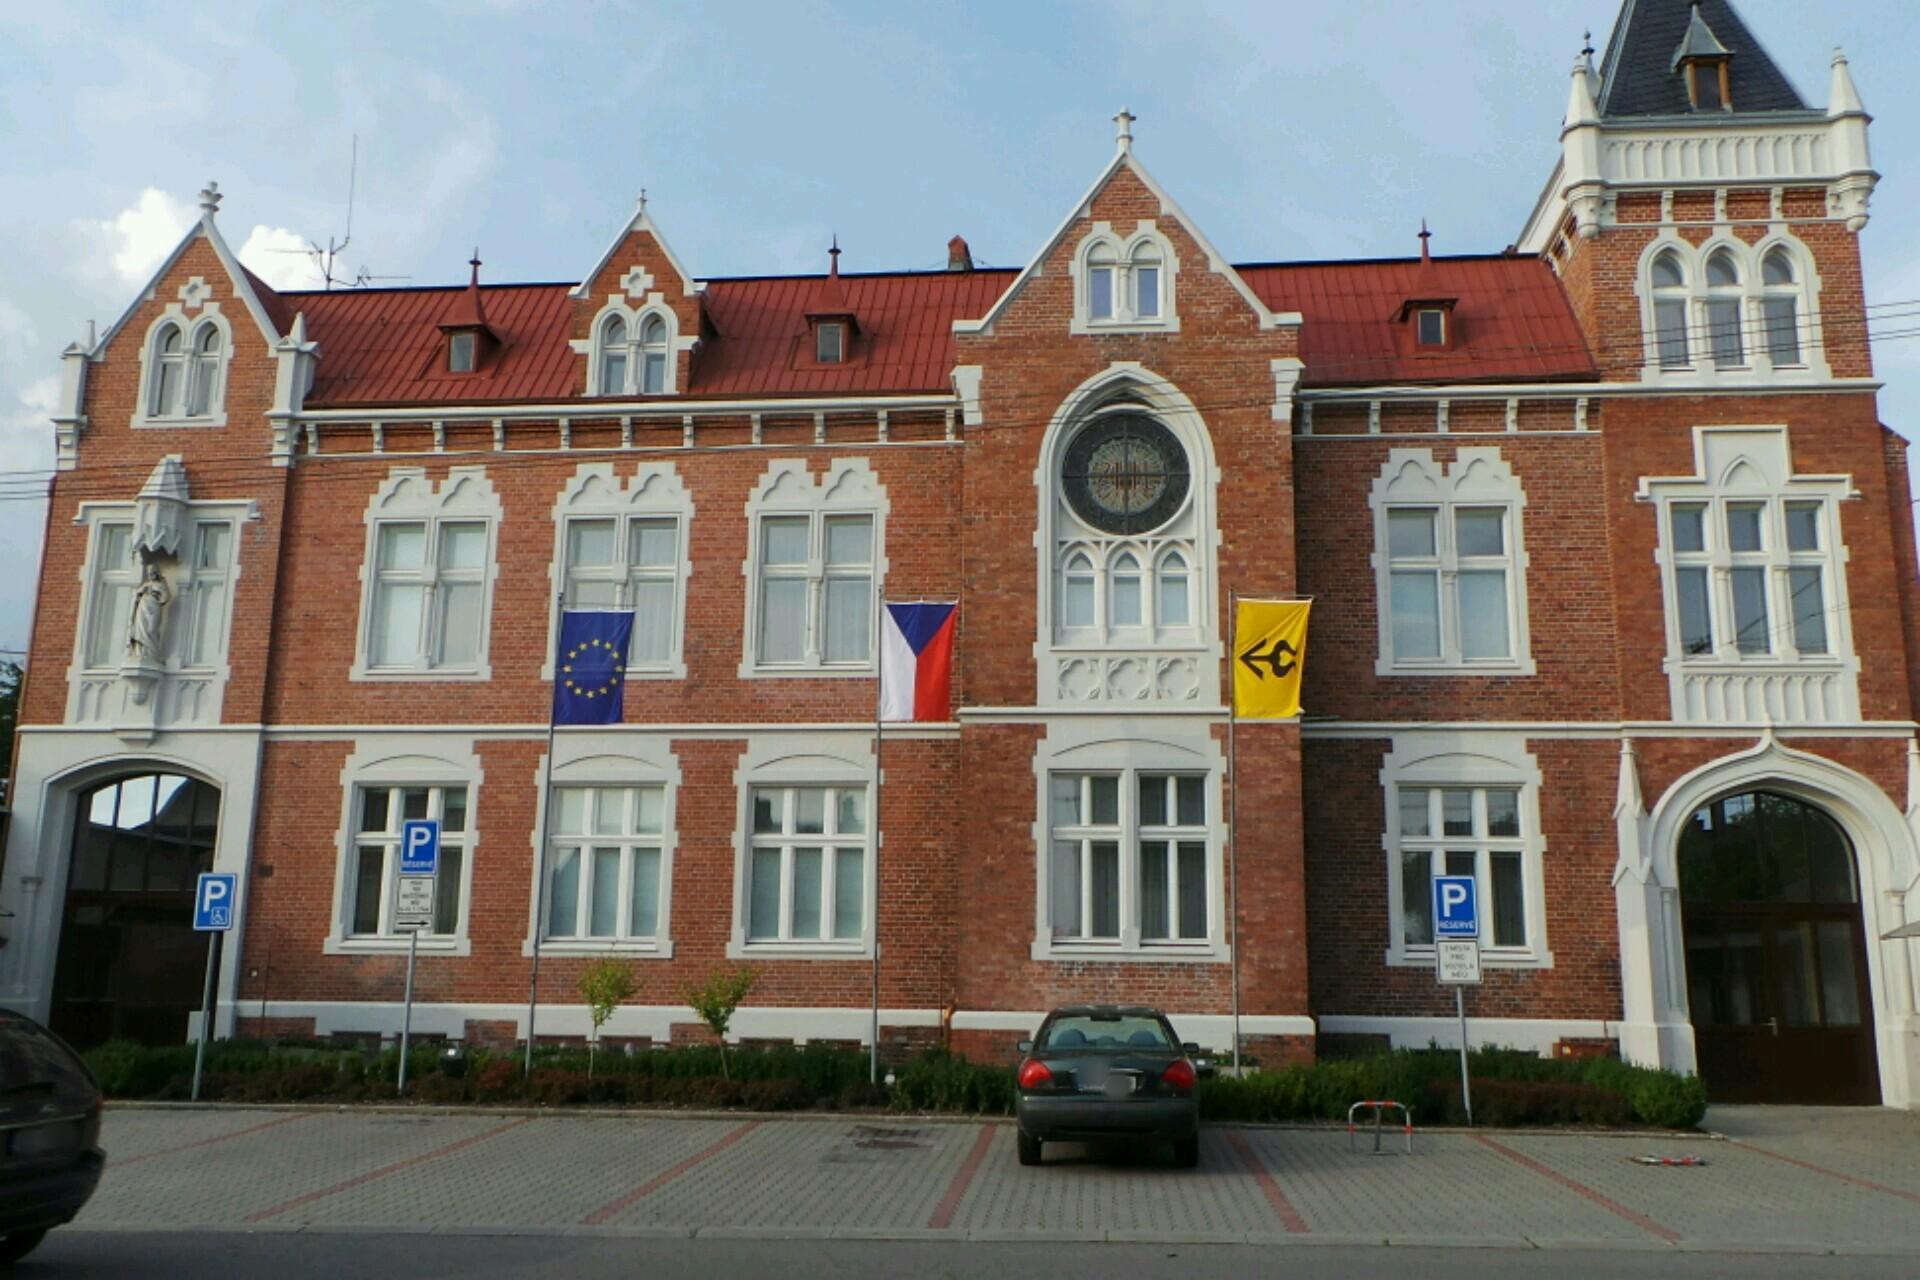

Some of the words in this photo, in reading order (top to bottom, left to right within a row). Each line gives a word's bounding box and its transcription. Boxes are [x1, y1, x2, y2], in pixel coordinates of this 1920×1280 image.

[407, 827, 432, 858] P
[203, 880, 227, 912] P
[1441, 884, 1467, 917] P
